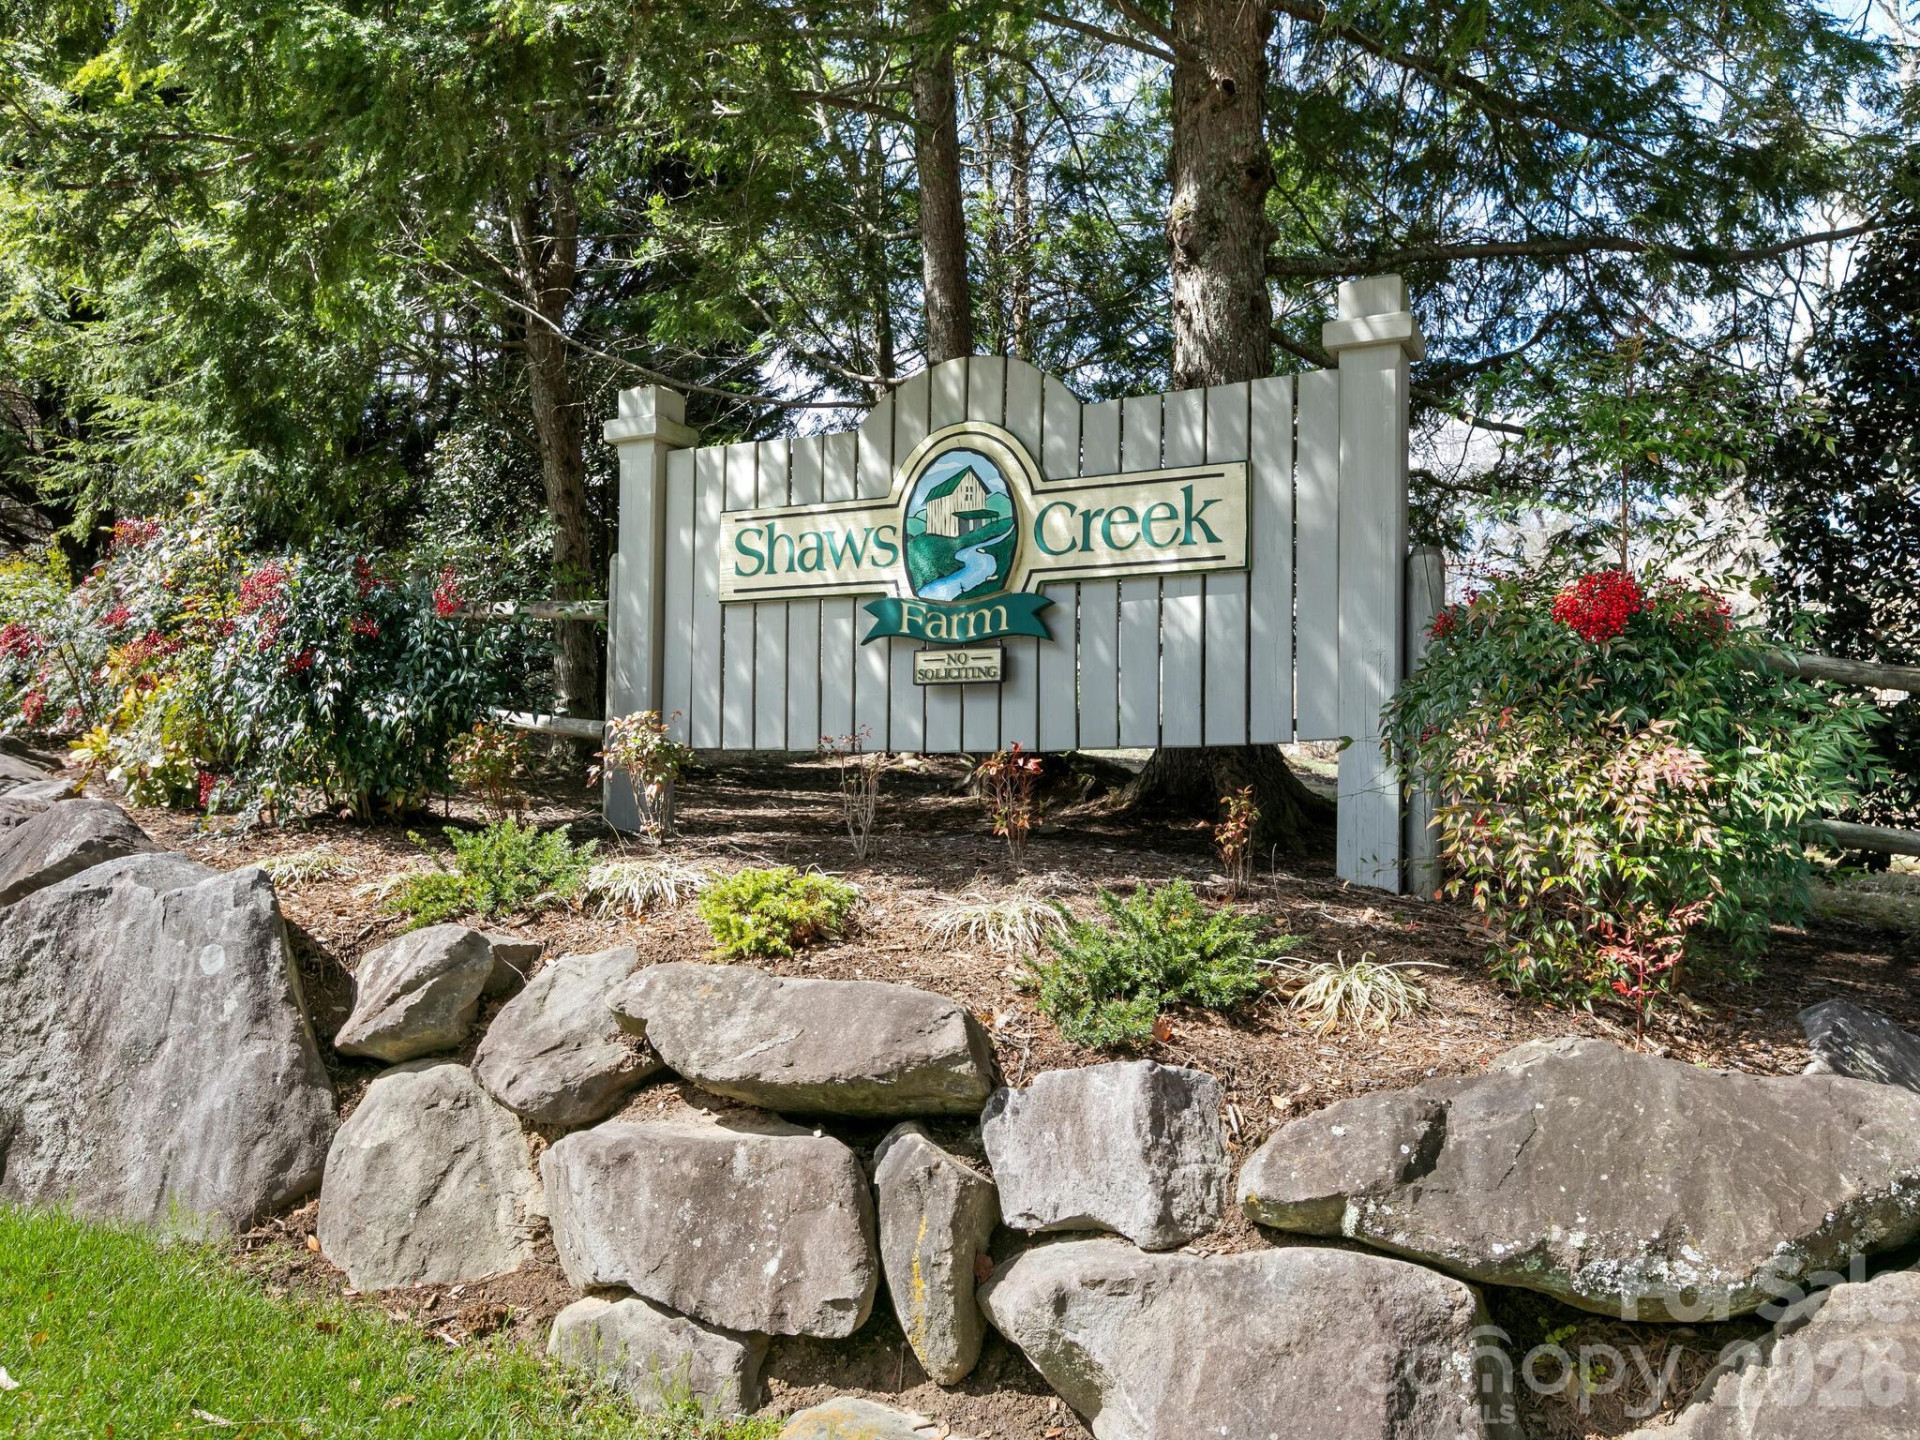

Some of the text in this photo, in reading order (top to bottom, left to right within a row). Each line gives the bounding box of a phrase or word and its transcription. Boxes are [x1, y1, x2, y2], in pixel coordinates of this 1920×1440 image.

[735, 484, 1223, 577] Shaws Creek
[900, 601, 1009, 640] Farm
[946, 652, 968, 665] NO
[917, 665, 999, 681] SOLICITING
